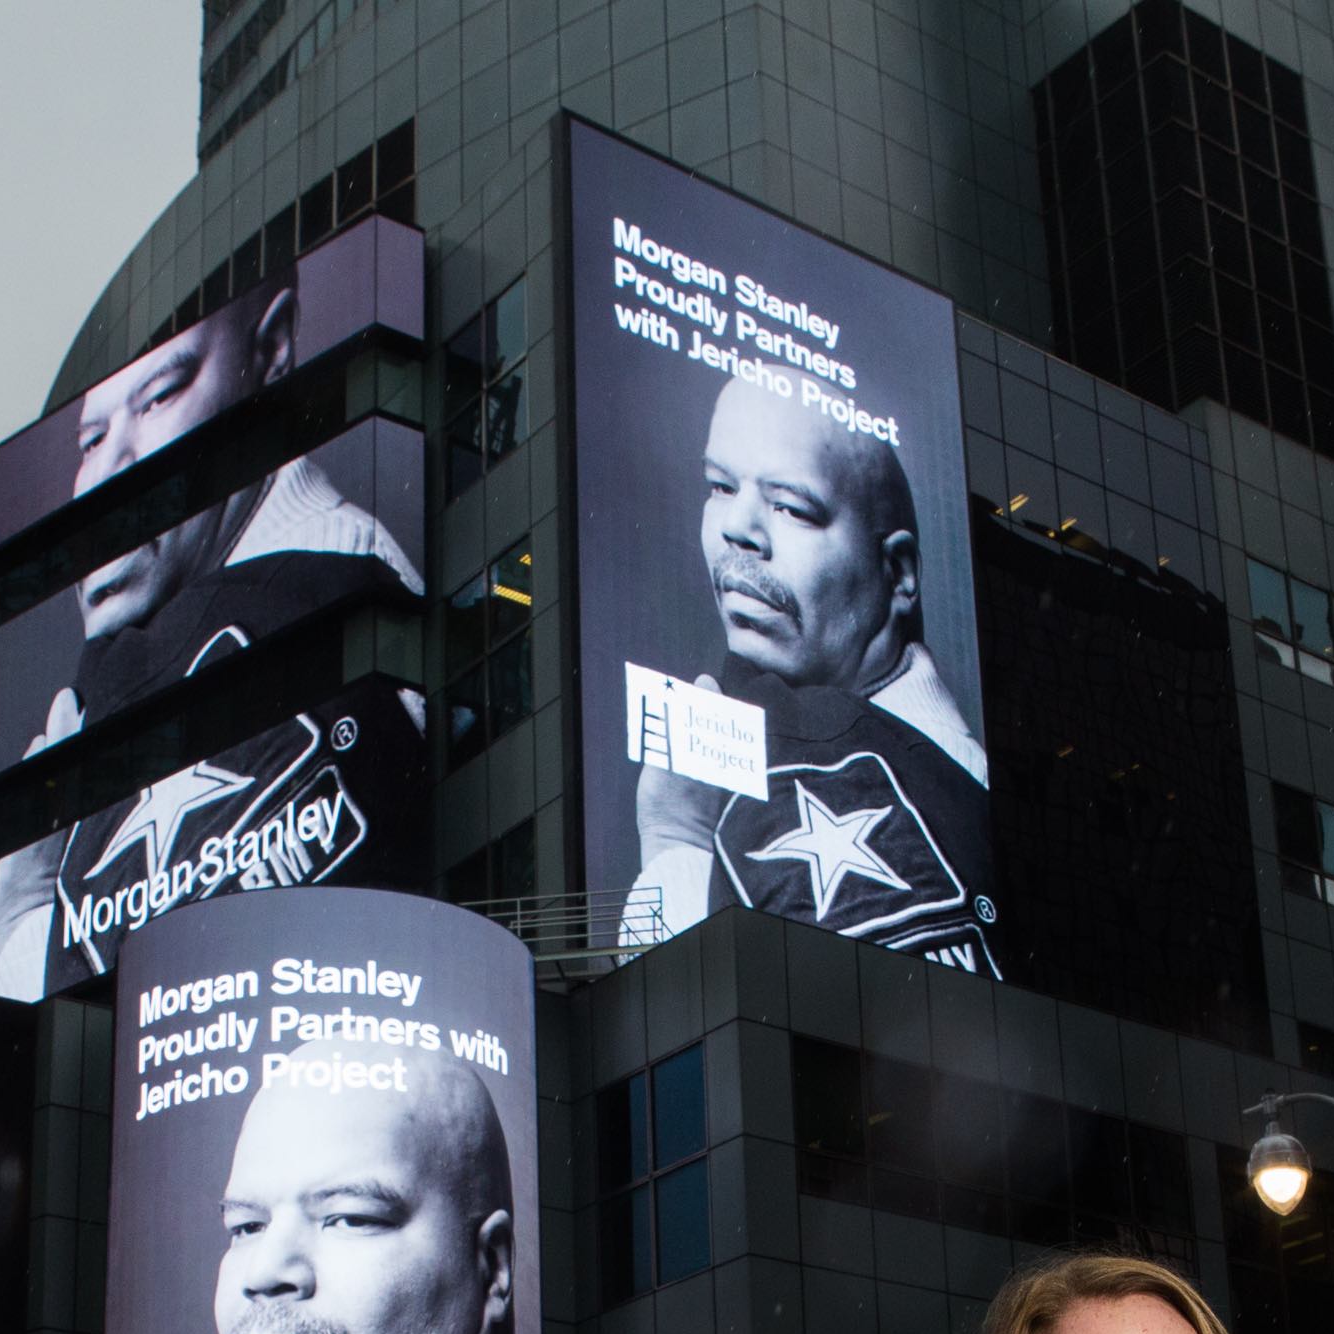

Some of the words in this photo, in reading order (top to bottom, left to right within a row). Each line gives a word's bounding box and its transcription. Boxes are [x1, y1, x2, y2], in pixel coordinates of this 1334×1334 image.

[613, 217, 727, 295] Morgan
[734, 274, 839, 349] Stanley
[614, 256, 728, 336] Proudly
[736, 311, 857, 389] Partners
[614, 304, 680, 351] with
[688, 331, 793, 397] Jericho
[801, 378, 900, 446] Project
[684, 705, 755, 745] Jericho
[689, 734, 755, 773] Project
[63, 859, 194, 948] Morgan
[199, 790, 344, 886] Stanley
[139, 968, 259, 1028] Morgan
[270, 958, 422, 1006] Stanley
[138, 1011, 259, 1074] Proudly
[270, 1006, 441, 1051] Partners
[450, 1029, 509, 1075] with
[135, 1062, 250, 1121] Jericho
[262, 1052, 408, 1094] Project
